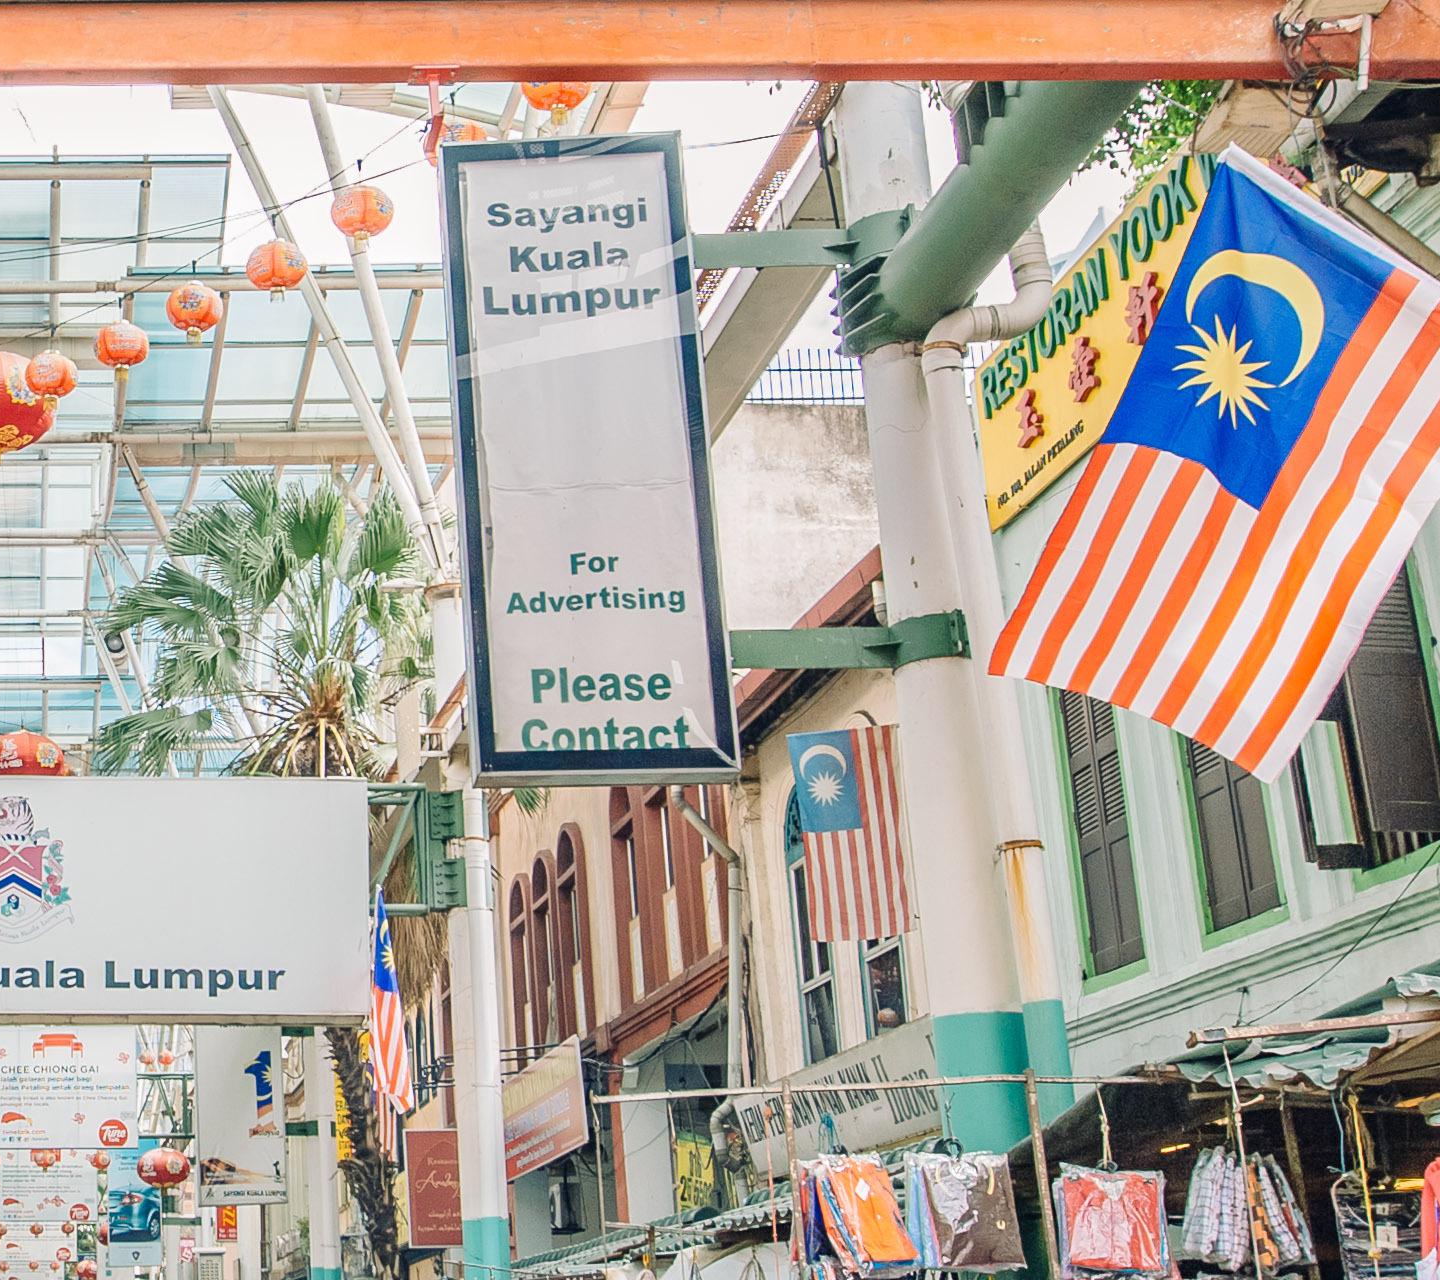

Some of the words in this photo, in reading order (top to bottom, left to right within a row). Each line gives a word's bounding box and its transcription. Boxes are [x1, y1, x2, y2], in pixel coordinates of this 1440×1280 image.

[486, 197, 648, 234] Sayangi
[508, 244, 631, 275] Kuala
[482, 285, 663, 319] Lumpur
[980, 247, 1110, 420] RESTORAN
[1108, 154, 1198, 282] YOOK
[569, 551, 620, 577] For
[505, 586, 687, 617] Advertising
[530, 666, 674, 705] Please
[520, 715, 691, 753] Contact
[103, 959, 287, 996] Lumpur
[0, 1065, 31, 1074] CHEE
[33, 1065, 78, 1075] CHIONG
[80, 1065, 100, 1074] GAI
[102, 1126, 127, 1141] Tune
